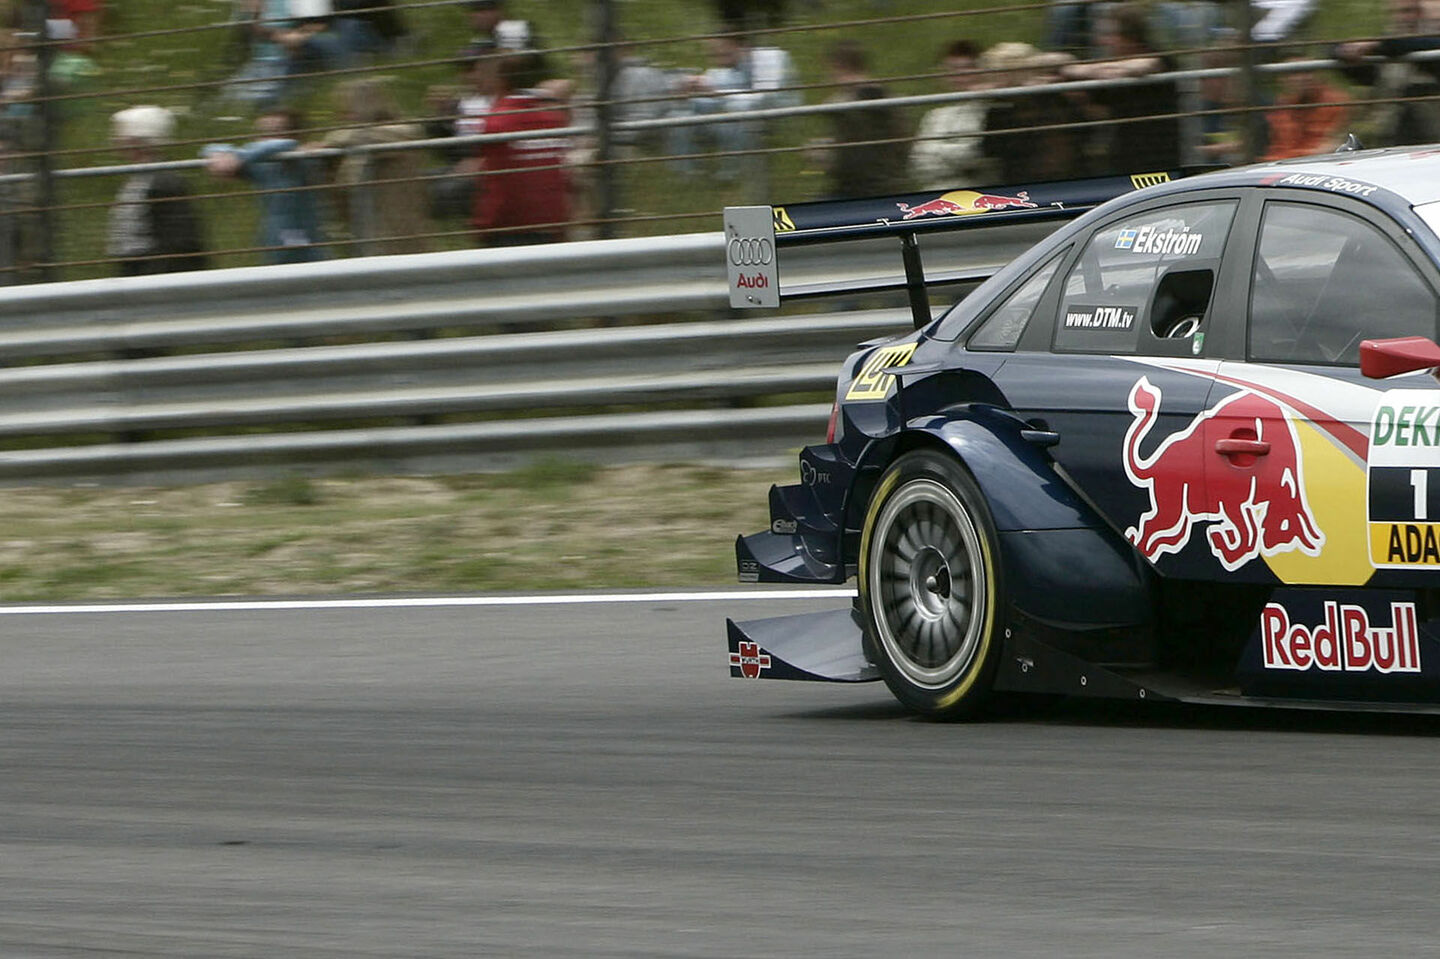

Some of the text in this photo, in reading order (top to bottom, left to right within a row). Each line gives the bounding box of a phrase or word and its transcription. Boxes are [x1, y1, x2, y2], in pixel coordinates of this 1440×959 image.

[1280, 173, 1377, 196] Audi Sport
[1133, 227, 1202, 254] Ekström
[737, 272, 769, 288] Audi
[1066, 307, 1134, 329] www.DTM.tv
[1410, 469, 1428, 520] 1
[1262, 604, 1418, 669] Red Bull
